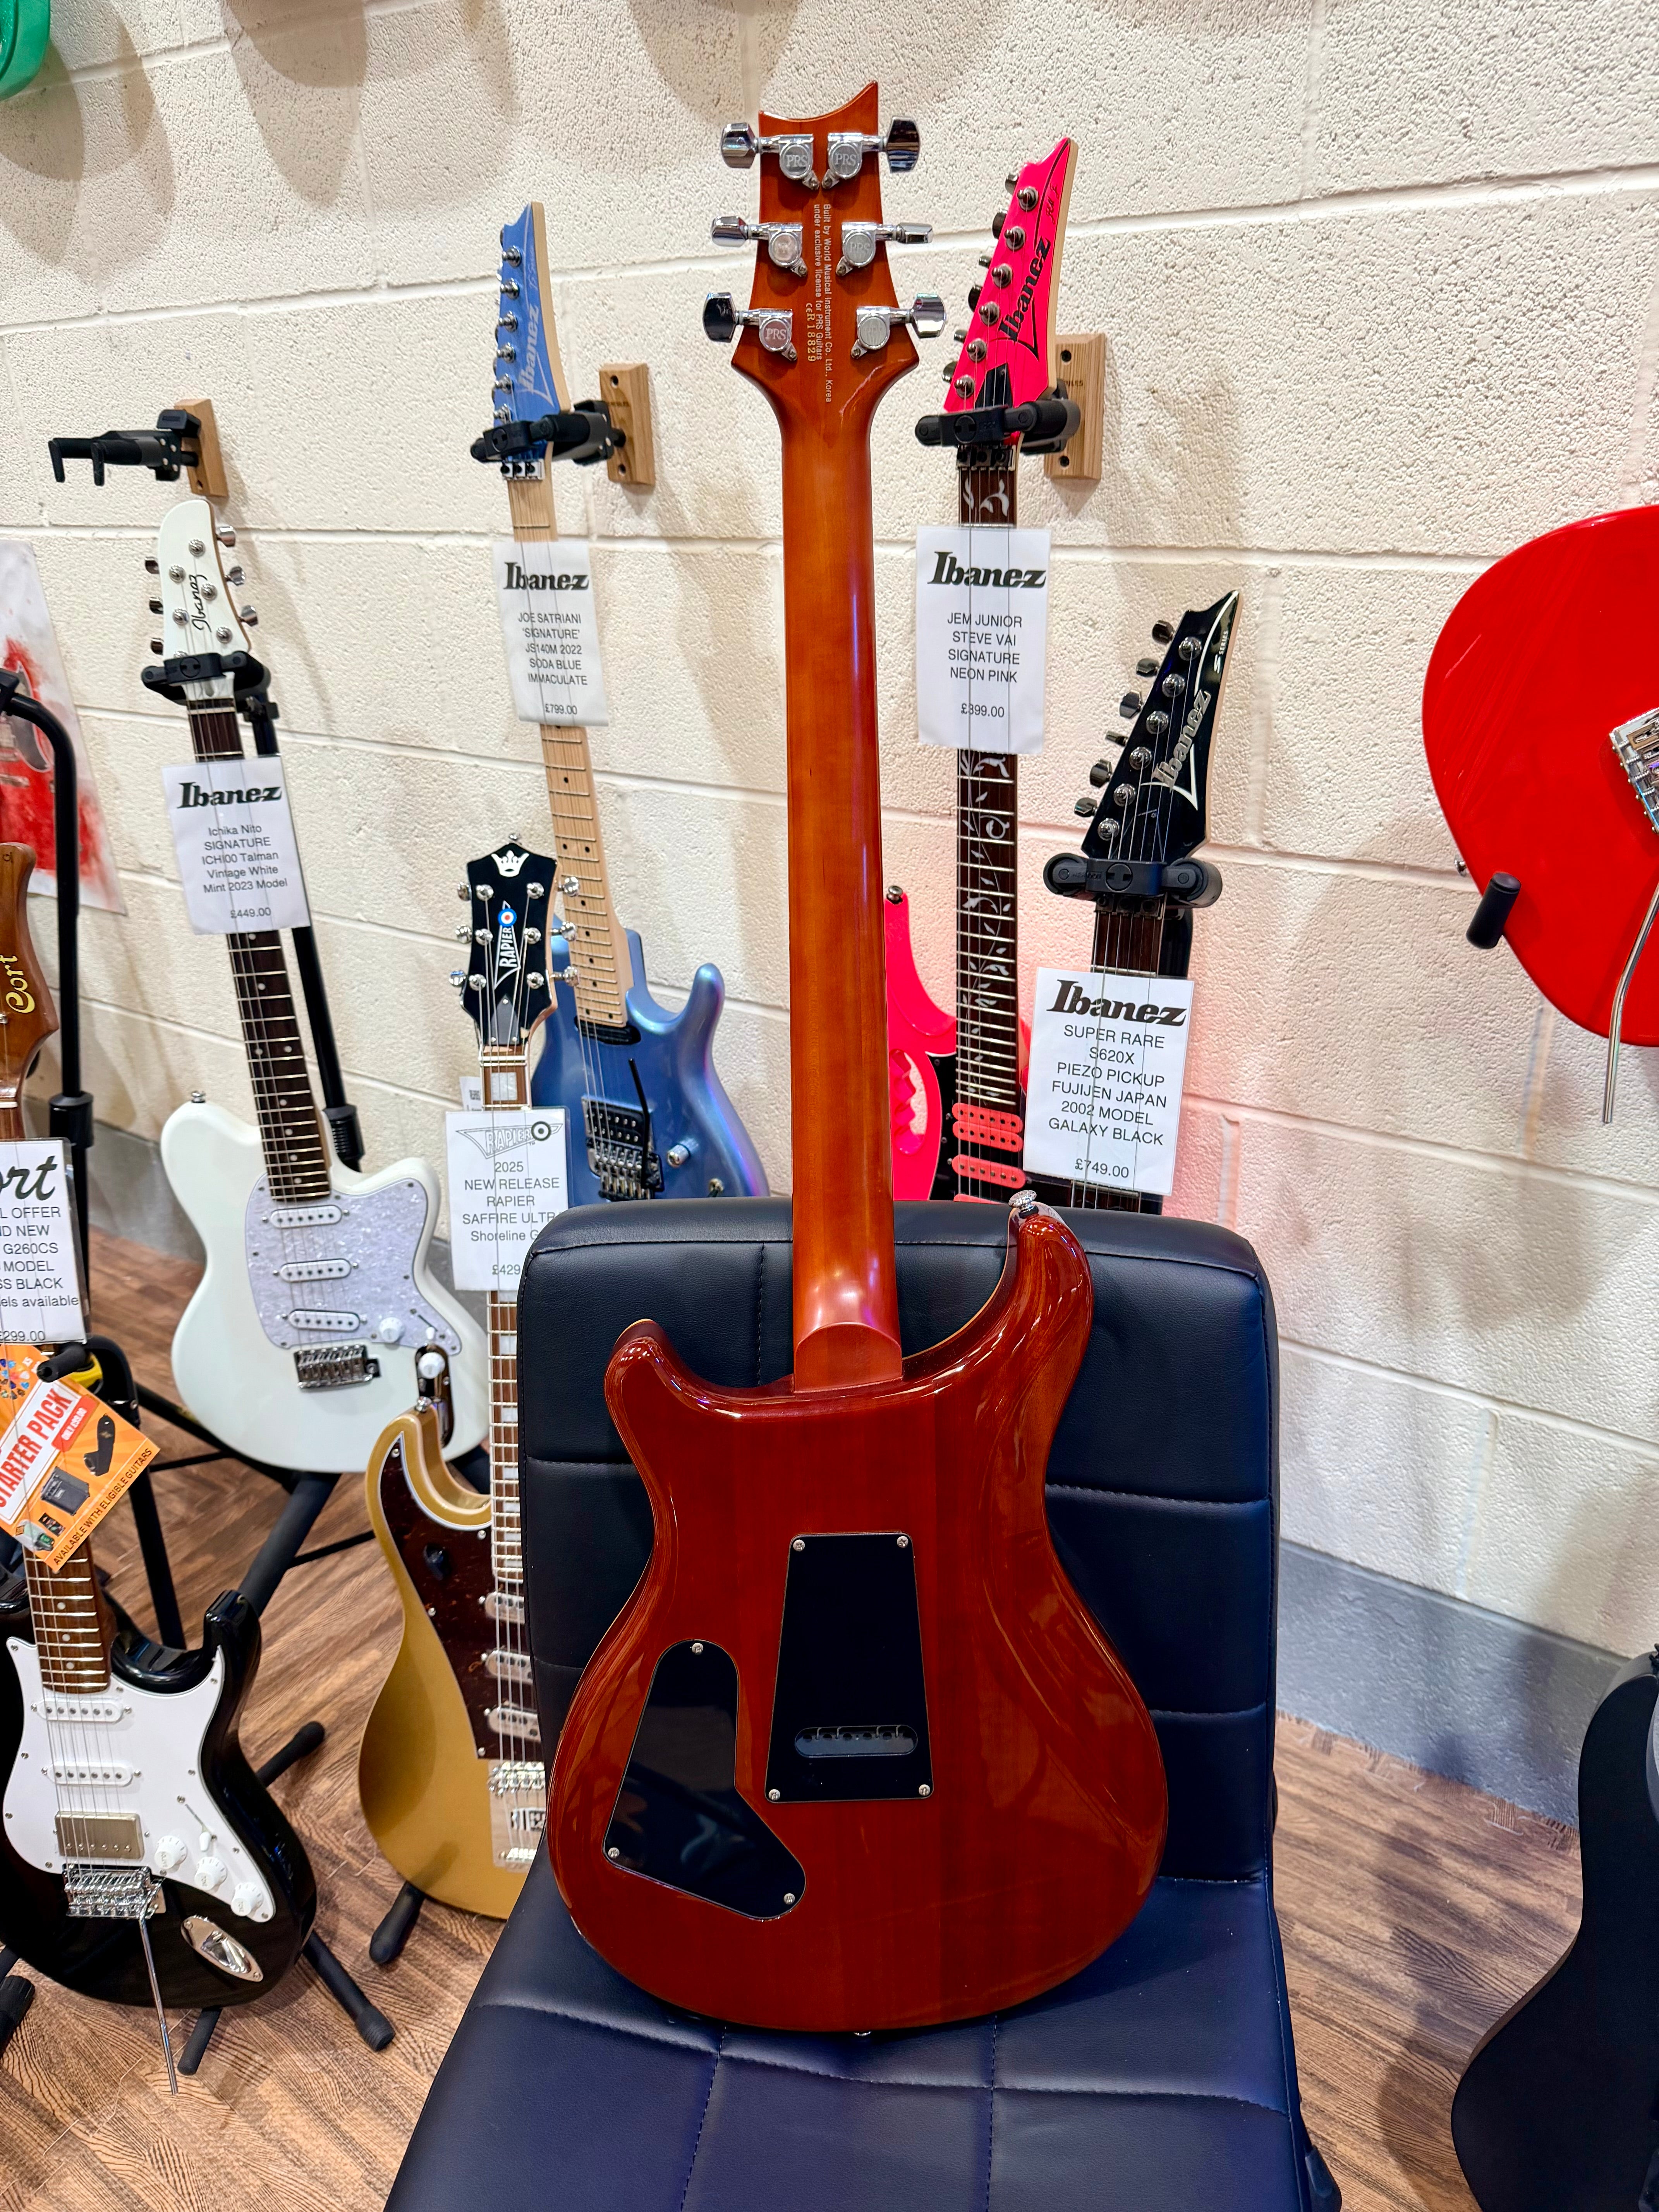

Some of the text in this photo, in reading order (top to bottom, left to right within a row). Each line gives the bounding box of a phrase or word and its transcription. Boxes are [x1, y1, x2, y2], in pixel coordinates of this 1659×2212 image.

[786, 155, 807, 167] PRS
[835, 153, 856, 166] PRS
[823, 225, 831, 235] by
[814, 230, 823, 266] exclusive
[824, 238, 832, 261] World
[815, 270, 824, 297] license
[824, 264, 832, 294] Musical
[998, 236, 1051, 344] Ibanez
[765, 327, 787, 340] PRS
[518, 303, 539, 395] Ibanez
[503, 562, 589, 591] Ibanez
[927, 551, 1047, 589] Ibanez
[191, 573, 212, 632] Ibanez
[518, 613, 581, 624] JOE SATRIANI
[947, 612, 1022, 628] JEM JUNIOR
[952, 631, 1016, 646] STEVE VAI
[525, 644, 582, 654] JS140M 2022
[529, 658, 582, 670] SODA BLUE
[948, 649, 1020, 665] SIGNATURE
[528, 673, 588, 685] IMMACULATE
[950, 667, 1017, 683] NEON PINK
[544, 704, 578, 715] £799.00
[1151, 689, 1211, 794] Ibanez
[177, 782, 282, 809] Ibanez
[208, 824, 262, 836] Ichika Nito
[204, 837, 271, 851] SIGNATURE
[239, 852, 279, 862] Talman
[207, 866, 278, 879] Vintage White
[203, 878, 288, 893] Mint 2023 Model
[230, 907, 271, 919] £449.00
[499, 927, 518, 967] RAPIER
[1046, 979, 1187, 1027] Ibanez
[1063, 1024, 1165, 1049] SUPER RARE
[1089, 1046, 1135, 1065] S620X
[1057, 1062, 1165, 1087] PIEZO PICKUP
[1052, 1080, 1167, 1108] FUJIJEN JAPAN
[1061, 1101, 1154, 1125] 2002 MODEL
[1048, 1118, 1164, 1146] GALAXY BLACK
[485, 1127, 534, 1154] RAPIER
[495, 1162, 524, 1173] 2025
[1074, 1158, 1129, 1179] £749.00
[464, 1178, 560, 1190] NEW RELEASE
[487, 1196, 535, 1206] RAPIER
[11, 1207, 61, 1219] OFFER
[462, 1212, 562, 1224] SAFFIRE ULTR
[16, 1224, 50, 1237] NEW
[471, 1230, 526, 1242] Shoreline
[3, 1242, 58, 1255] G260CS
[3, 1261, 55, 1272] MODEL
[492, 1264, 520, 1275] £429
[15, 1278, 64, 1290] BLACK
[22, 1295, 79, 1307] available
[26, 1388, 73, 1441] PACK
[53, 1526, 87, 1565] AVAILABLE
[83, 1508, 103, 1527] WITH
[100, 1477, 129, 1510] ELIGIBLE
[125, 1448, 153, 1479] GUITARS
